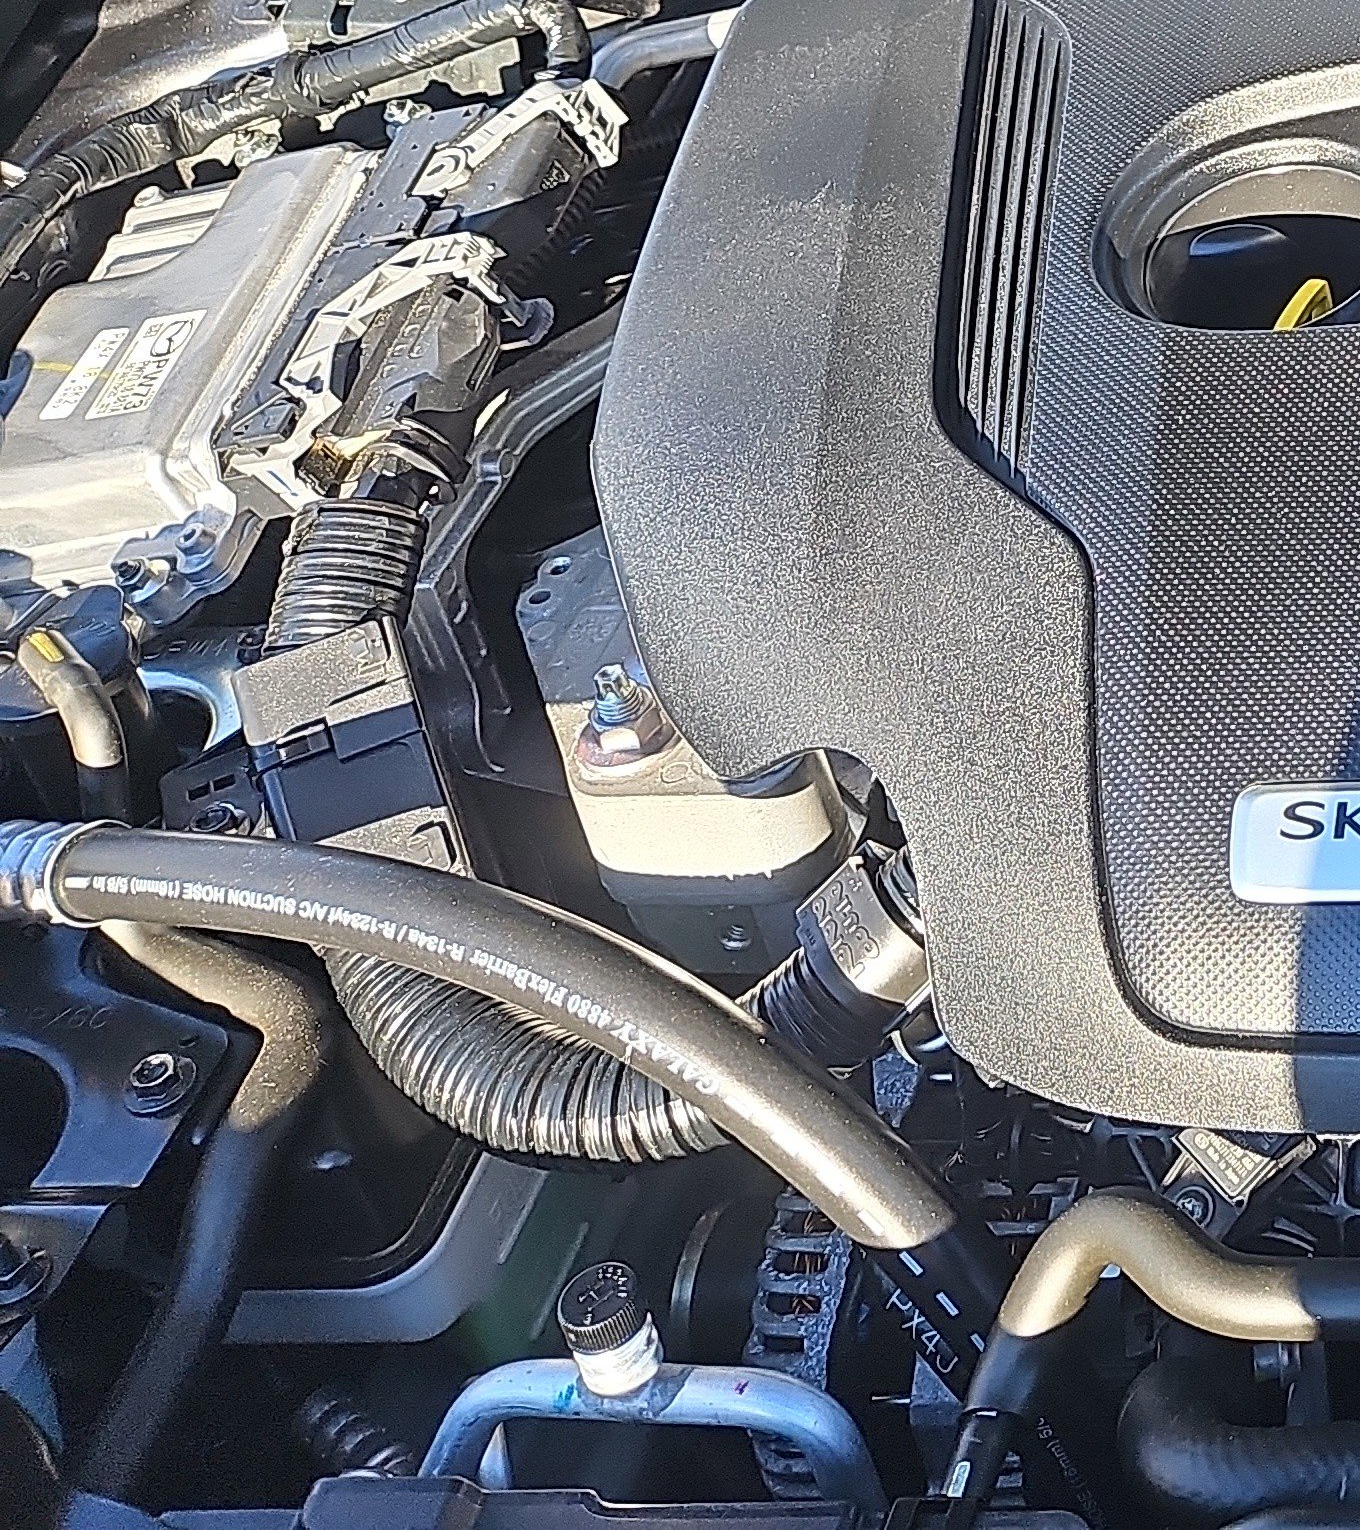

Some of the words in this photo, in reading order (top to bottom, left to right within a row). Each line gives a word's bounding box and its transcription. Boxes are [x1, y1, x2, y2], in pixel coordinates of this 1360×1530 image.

[123, 358, 170, 411] PW73
[182, 882, 225, 903] HOSE
[226, 888, 297, 916] SUCTION
[298, 900, 327, 923] A/C
[326, 905, 397, 940] R-1234yf
[408, 927, 466, 963] R-134a
[468, 947, 565, 1007] FlexBarrier
[566, 991, 613, 1029] 4880
[610, 1021, 720, 1096] GALAXY
[886, 1288, 959, 1374] PX4J
